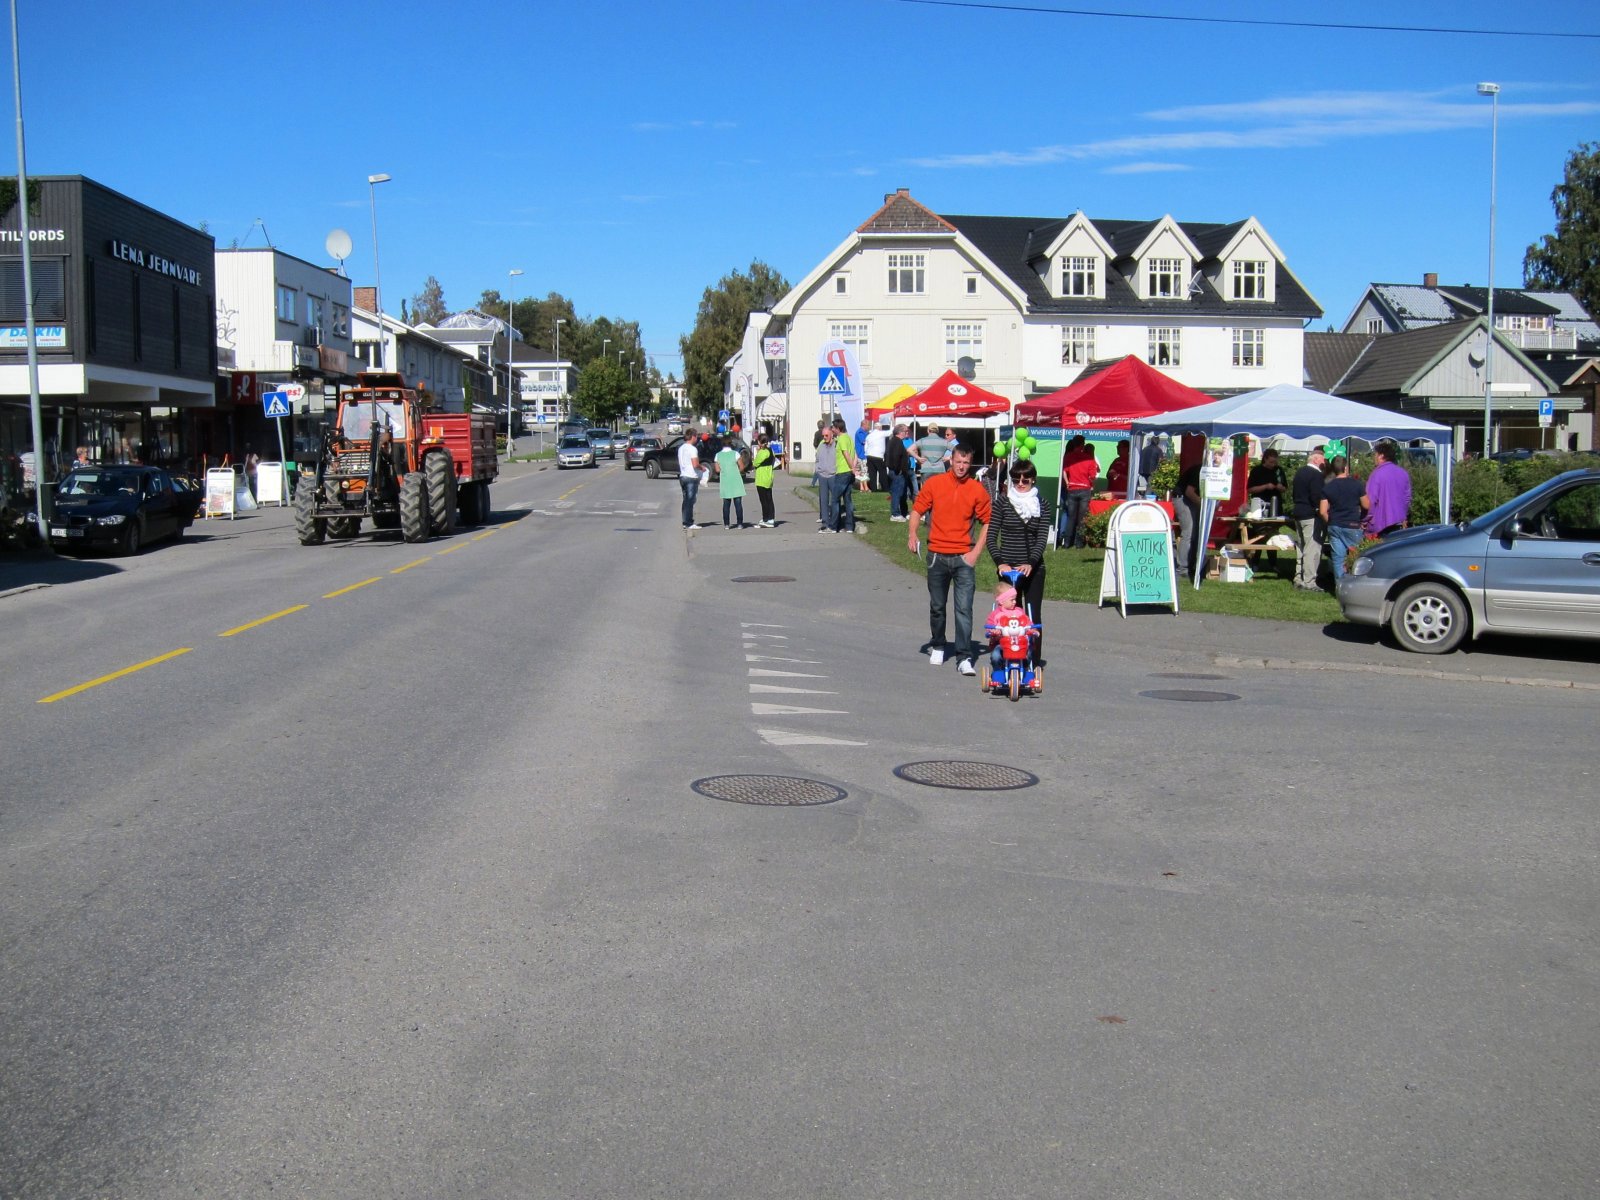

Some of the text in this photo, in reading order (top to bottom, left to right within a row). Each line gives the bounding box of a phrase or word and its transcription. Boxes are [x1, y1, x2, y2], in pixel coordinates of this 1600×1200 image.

[0, 230, 65, 242] TILORDS
[113, 240, 202, 287] LENA JERNVARE
[10, 327, 62, 337] DAKIN
[1542, 401, 1550, 414] P
[1030, 428, 1083, 436] www.vensre.no
[1125, 537, 1167, 556] ANTIKK
[1138, 556, 1154, 565] OG
[1131, 565, 1168, 581] BRUKT
